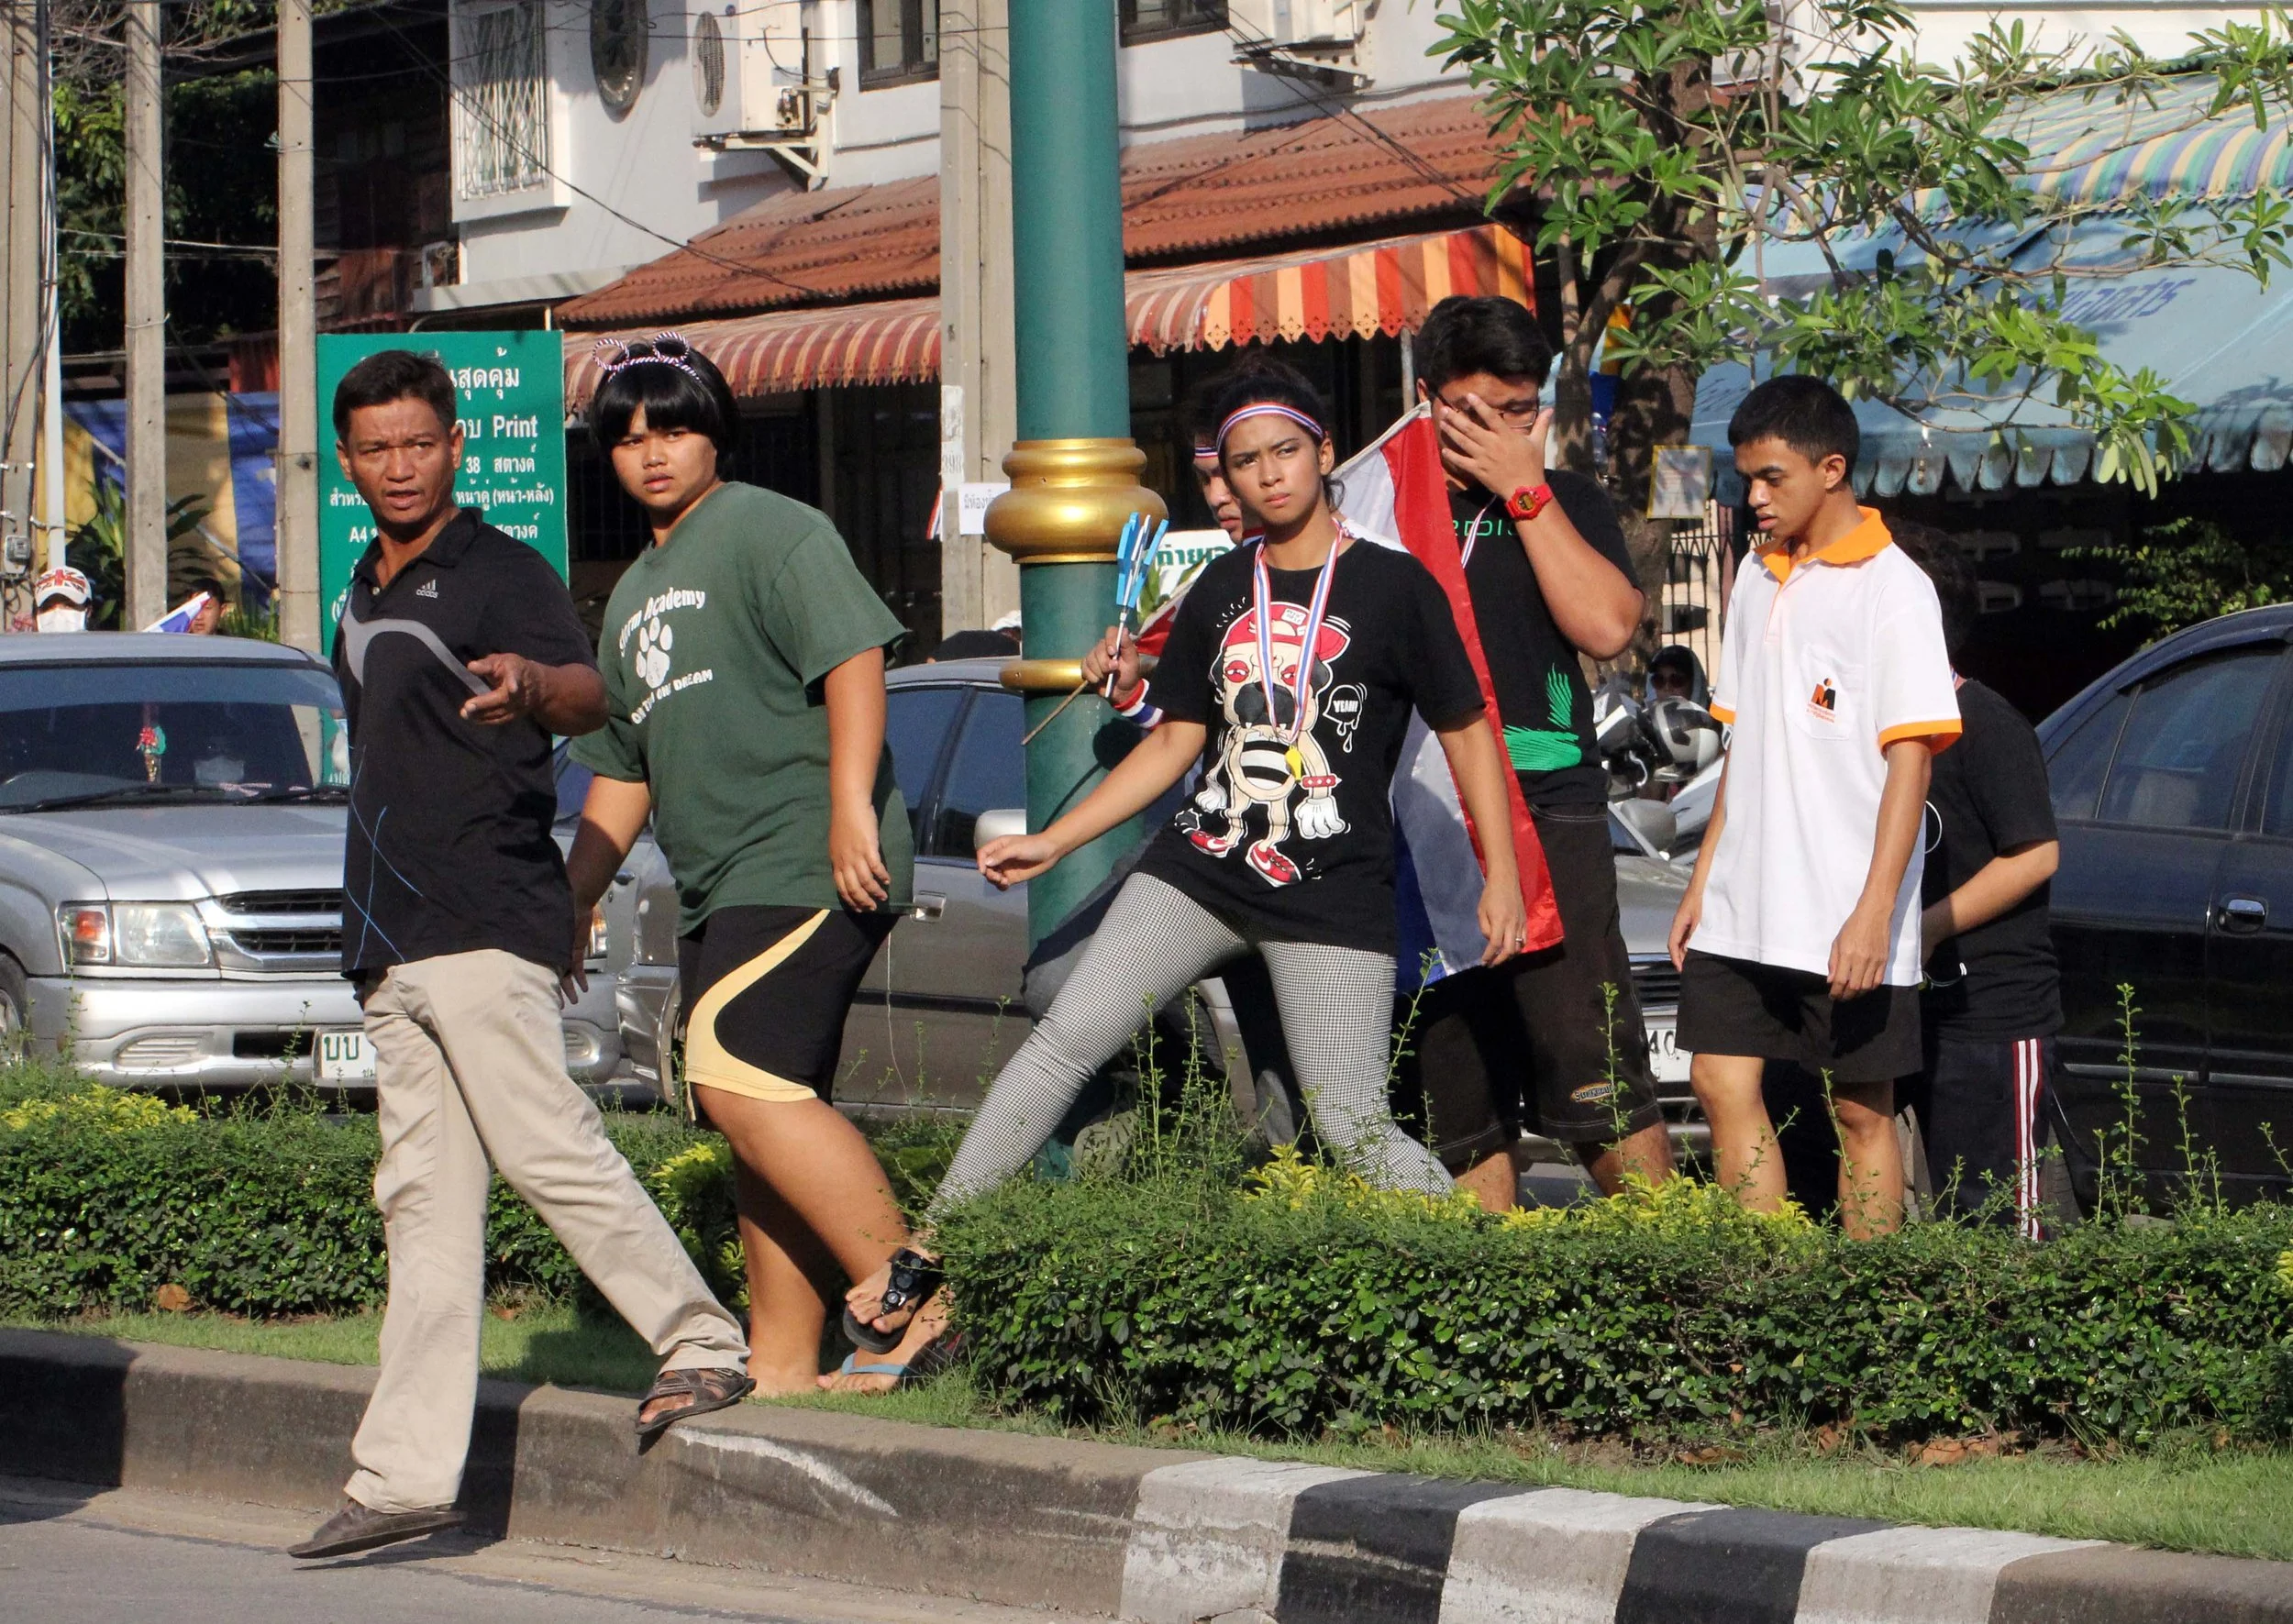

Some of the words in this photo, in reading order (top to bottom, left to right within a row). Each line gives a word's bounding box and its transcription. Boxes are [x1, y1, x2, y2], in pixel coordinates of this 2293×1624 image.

[493, 414, 538, 438] Print
[466, 456, 481, 474] 38
[493, 443, 536, 473] สตางค์
[349, 525, 368, 543] A4
[644, 587, 705, 621] Academy
[672, 668, 714, 691] DREAM
